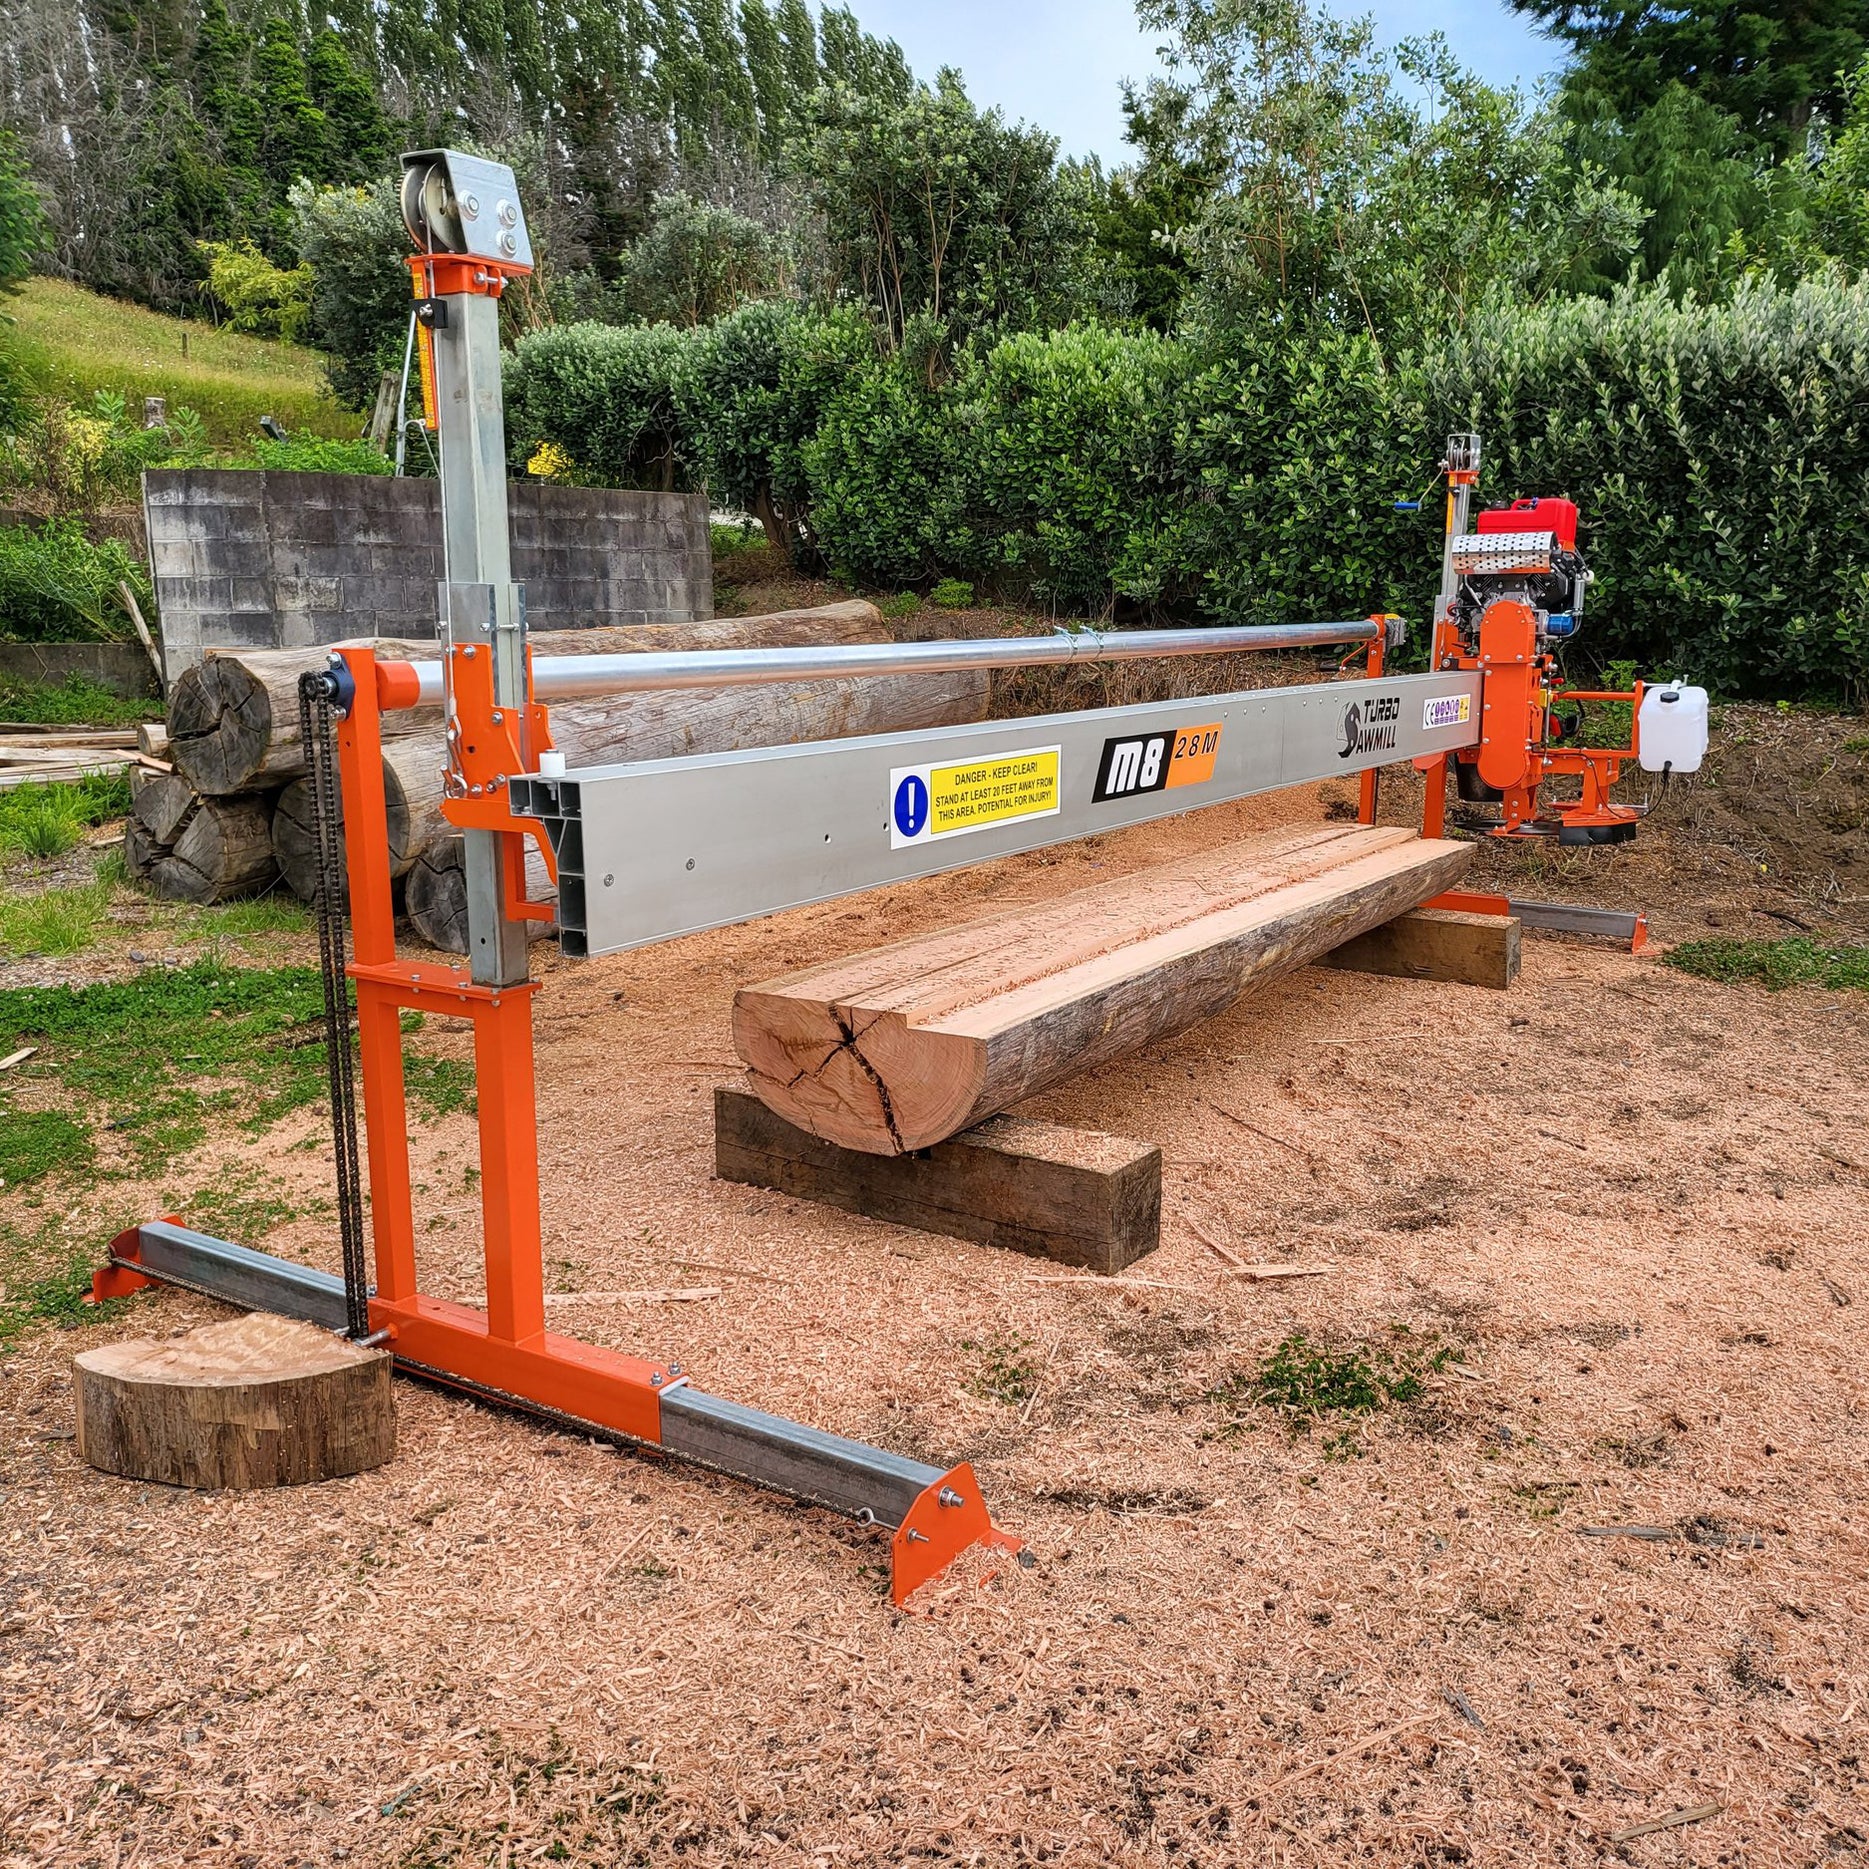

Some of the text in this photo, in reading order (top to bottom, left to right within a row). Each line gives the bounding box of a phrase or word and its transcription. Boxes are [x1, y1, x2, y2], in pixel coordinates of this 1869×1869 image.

[1364, 697, 1400, 724] TURBO
[1338, 702, 1397, 758] SAWMILL
[955, 770, 987, 786] DANGER
[992, 766, 1011, 780] KEEP
[1013, 761, 1038, 776] CLEAR!
[1105, 740, 1165, 795] M8
[935, 776, 1054, 807] STAND AT LEAST 20 FEET AWAY FROM
[938, 790, 1052, 822] THIS AREA. POTENTIAL FOR INJURY!
